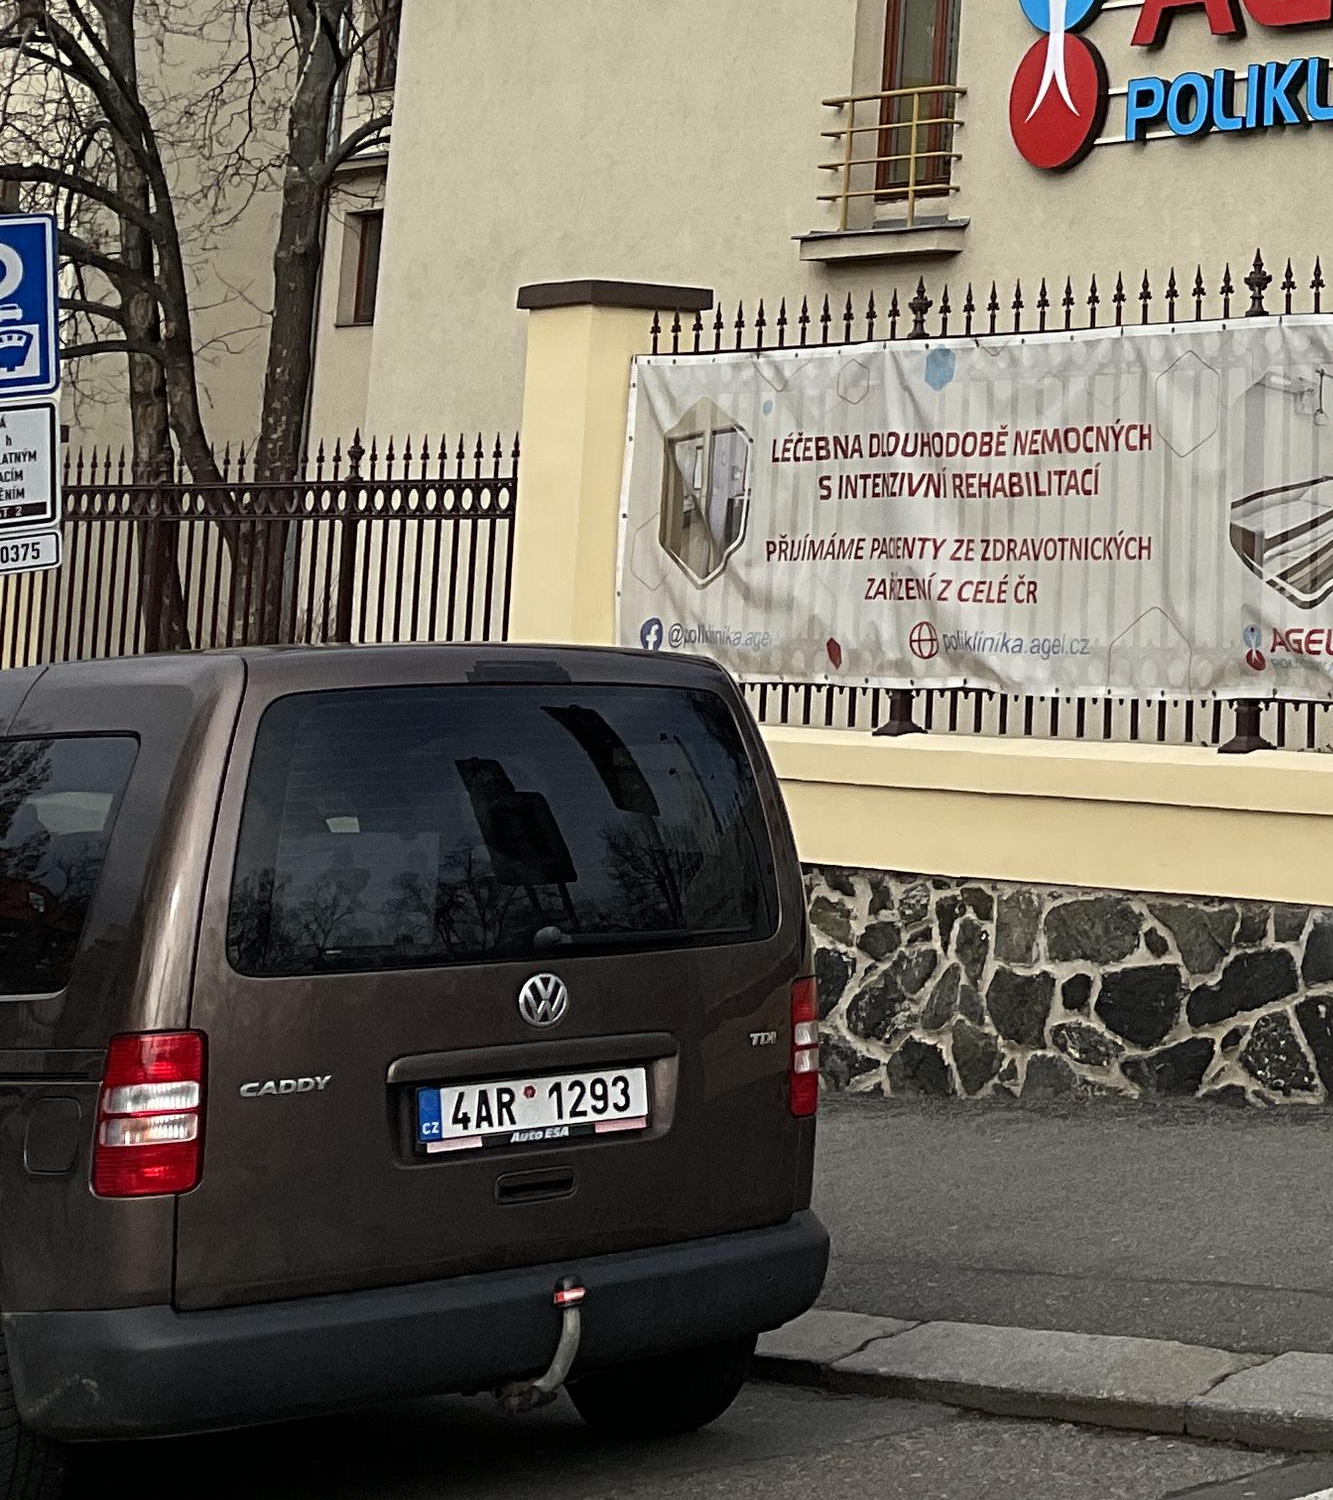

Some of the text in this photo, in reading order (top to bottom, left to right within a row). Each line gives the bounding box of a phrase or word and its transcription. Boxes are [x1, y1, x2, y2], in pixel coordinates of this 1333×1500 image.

[771, 418, 1152, 463] LÉČEBNA DLOUHODOBĚ NEMOCNÝCH
[818, 462, 1101, 501] S INTENZIVNÍ REHABILITACÍ
[0, 541, 41, 564] 0375
[765, 532, 866, 562] PŘIJÍMÁME
[949, 538, 975, 561] ZE
[980, 530, 1152, 562] ZDRAVOTNICKÝCH
[936, 579, 953, 602] Z
[956, 574, 1009, 604] CELÉ
[1013, 573, 1039, 604] ČR
[942, 630, 1090, 661] poliklinika.agel.cz
[239, 1074, 333, 1098] CADDY
[451, 1075, 631, 1132] 4AR 1293
[421, 1121, 440, 1135] CZ
[510, 1130, 543, 1144] Auto
